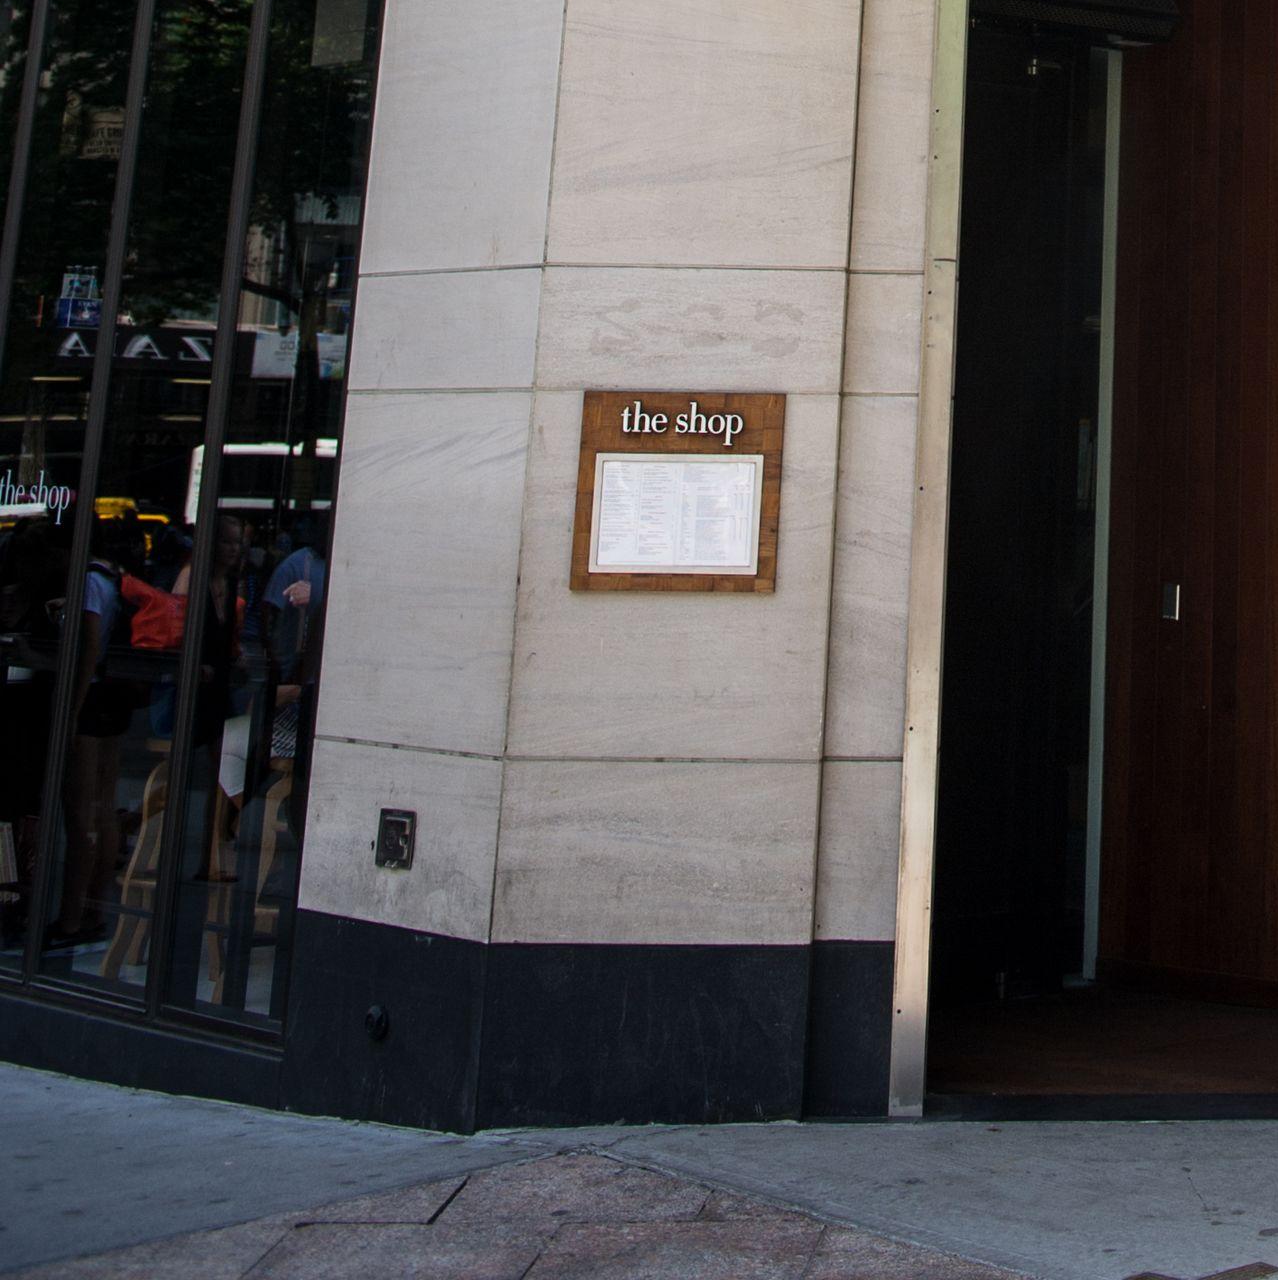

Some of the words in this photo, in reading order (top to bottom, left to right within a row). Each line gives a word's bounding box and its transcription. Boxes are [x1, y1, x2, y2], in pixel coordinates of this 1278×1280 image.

[620, 400, 668, 433] the
[675, 401, 744, 446] shop
[0, 468, 26, 507] the
[29, 469, 70, 525] shop
